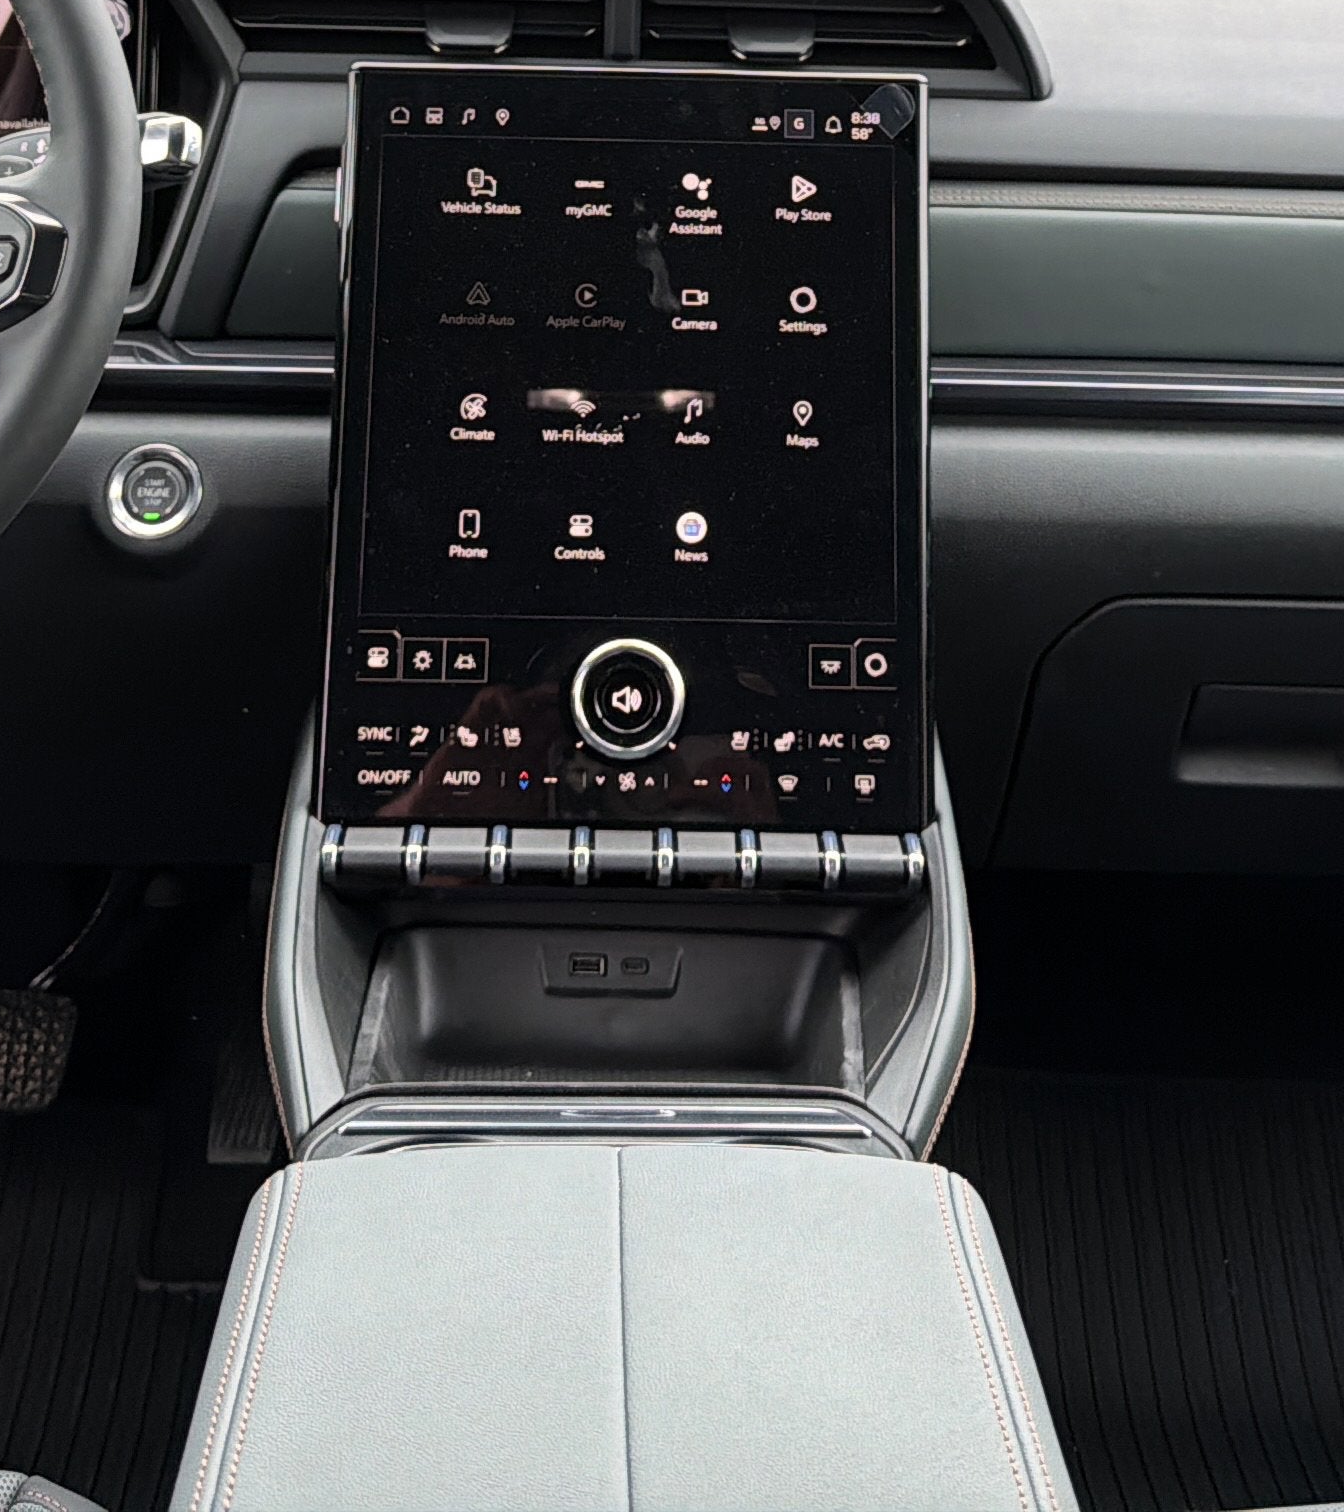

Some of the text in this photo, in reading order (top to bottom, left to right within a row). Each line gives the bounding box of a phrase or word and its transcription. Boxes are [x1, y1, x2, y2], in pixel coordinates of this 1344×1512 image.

[793, 118, 804, 130] G
[850, 112, 880, 124] 8:38
[851, 128, 874, 140] 58°
[441, 202, 521, 216] Vehicle Status
[566, 204, 612, 218] myGMC
[676, 206, 717, 221] Google
[775, 208, 832, 224] Play Store
[669, 222, 722, 236] Assistant
[440, 313, 516, 327] Android Auto
[546, 315, 626, 332] Apple CarPlay
[672, 318, 718, 332] Camera
[779, 320, 828, 336] Settings
[450, 428, 495, 442] Climate
[542, 429, 624, 446] Wi-Fi Hotspot
[676, 430, 710, 445] Audio
[786, 434, 818, 449] Maps
[449, 544, 488, 559] Phone
[554, 546, 605, 560] Controls
[674, 548, 708, 562] News
[358, 726, 393, 742] SYNC
[818, 734, 844, 748] A/C
[358, 770, 412, 786] ON/OFF
[442, 770, 480, 785] AUTO
